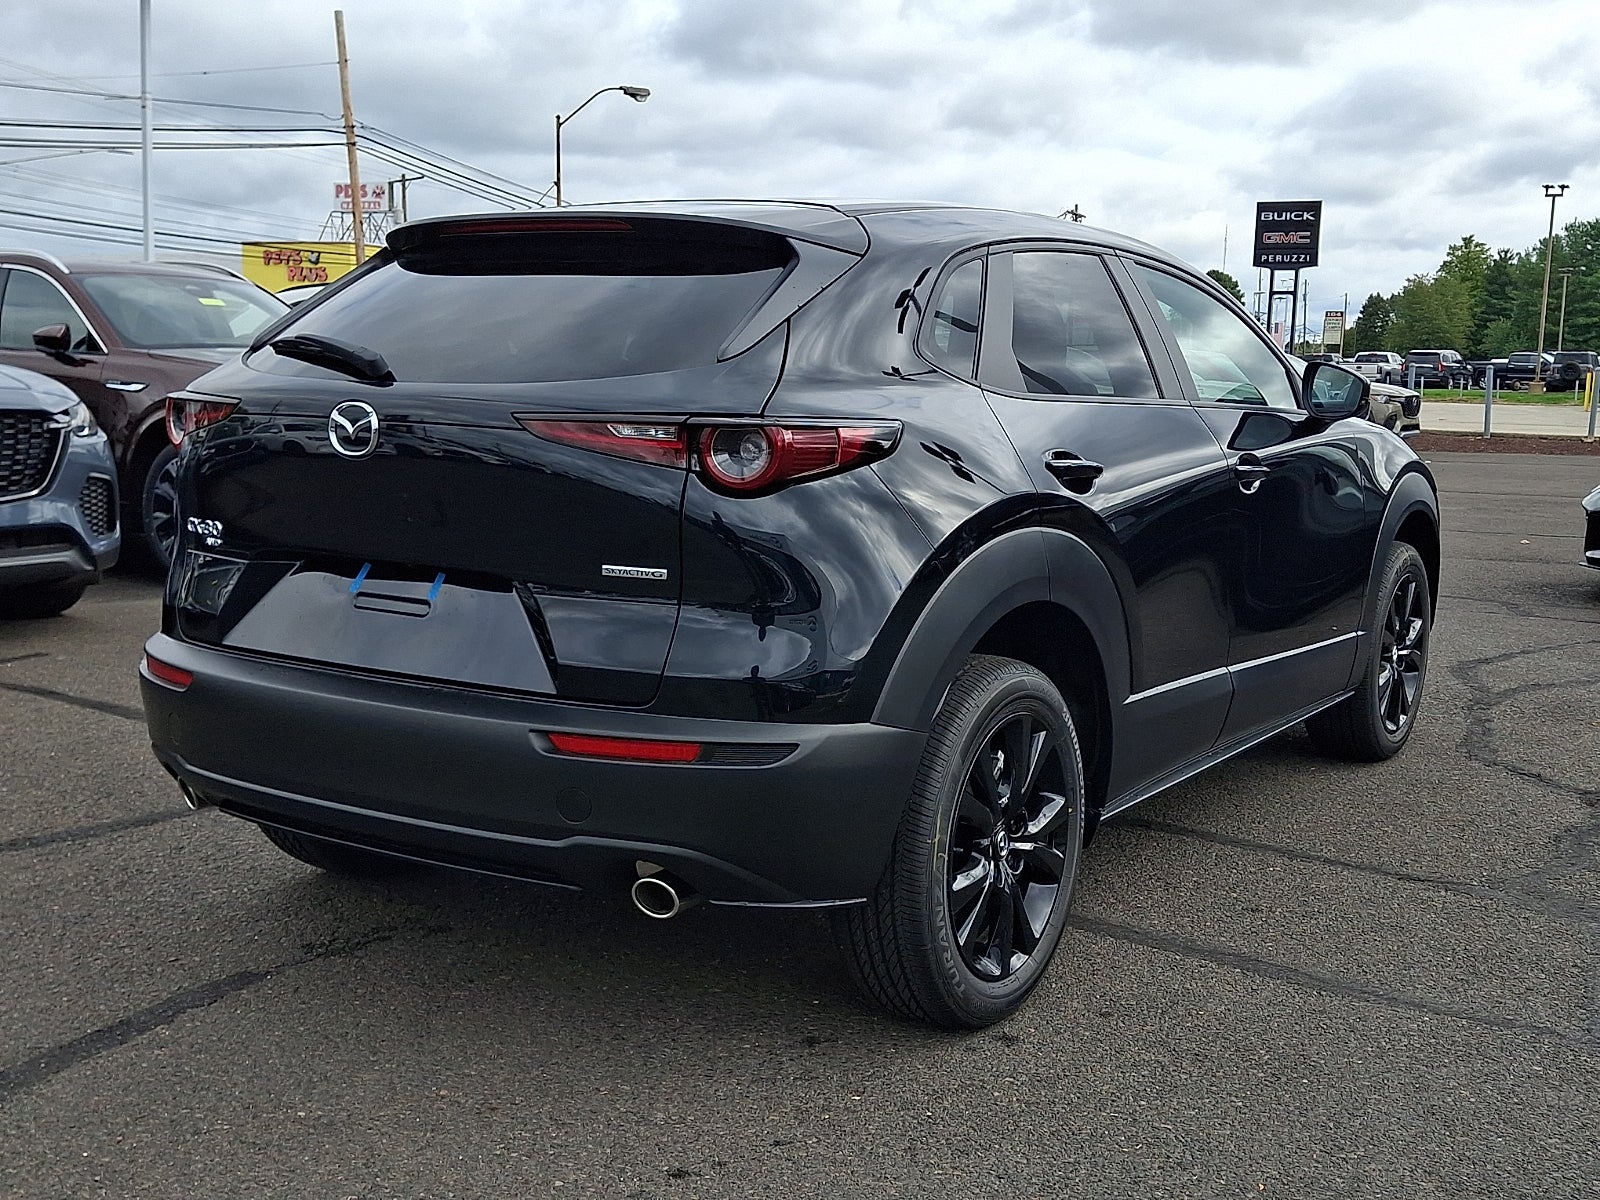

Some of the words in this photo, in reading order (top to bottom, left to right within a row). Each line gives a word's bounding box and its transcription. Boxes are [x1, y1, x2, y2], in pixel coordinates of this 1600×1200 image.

[335, 184, 368, 198] PES
[1261, 211, 1316, 221] BUICK
[1263, 231, 1311, 244] GMC
[263, 249, 302, 265] PETS
[1261, 254, 1311, 263] PERUZZI
[287, 265, 328, 282] PLUS
[932, 865, 967, 999] TURANZA
